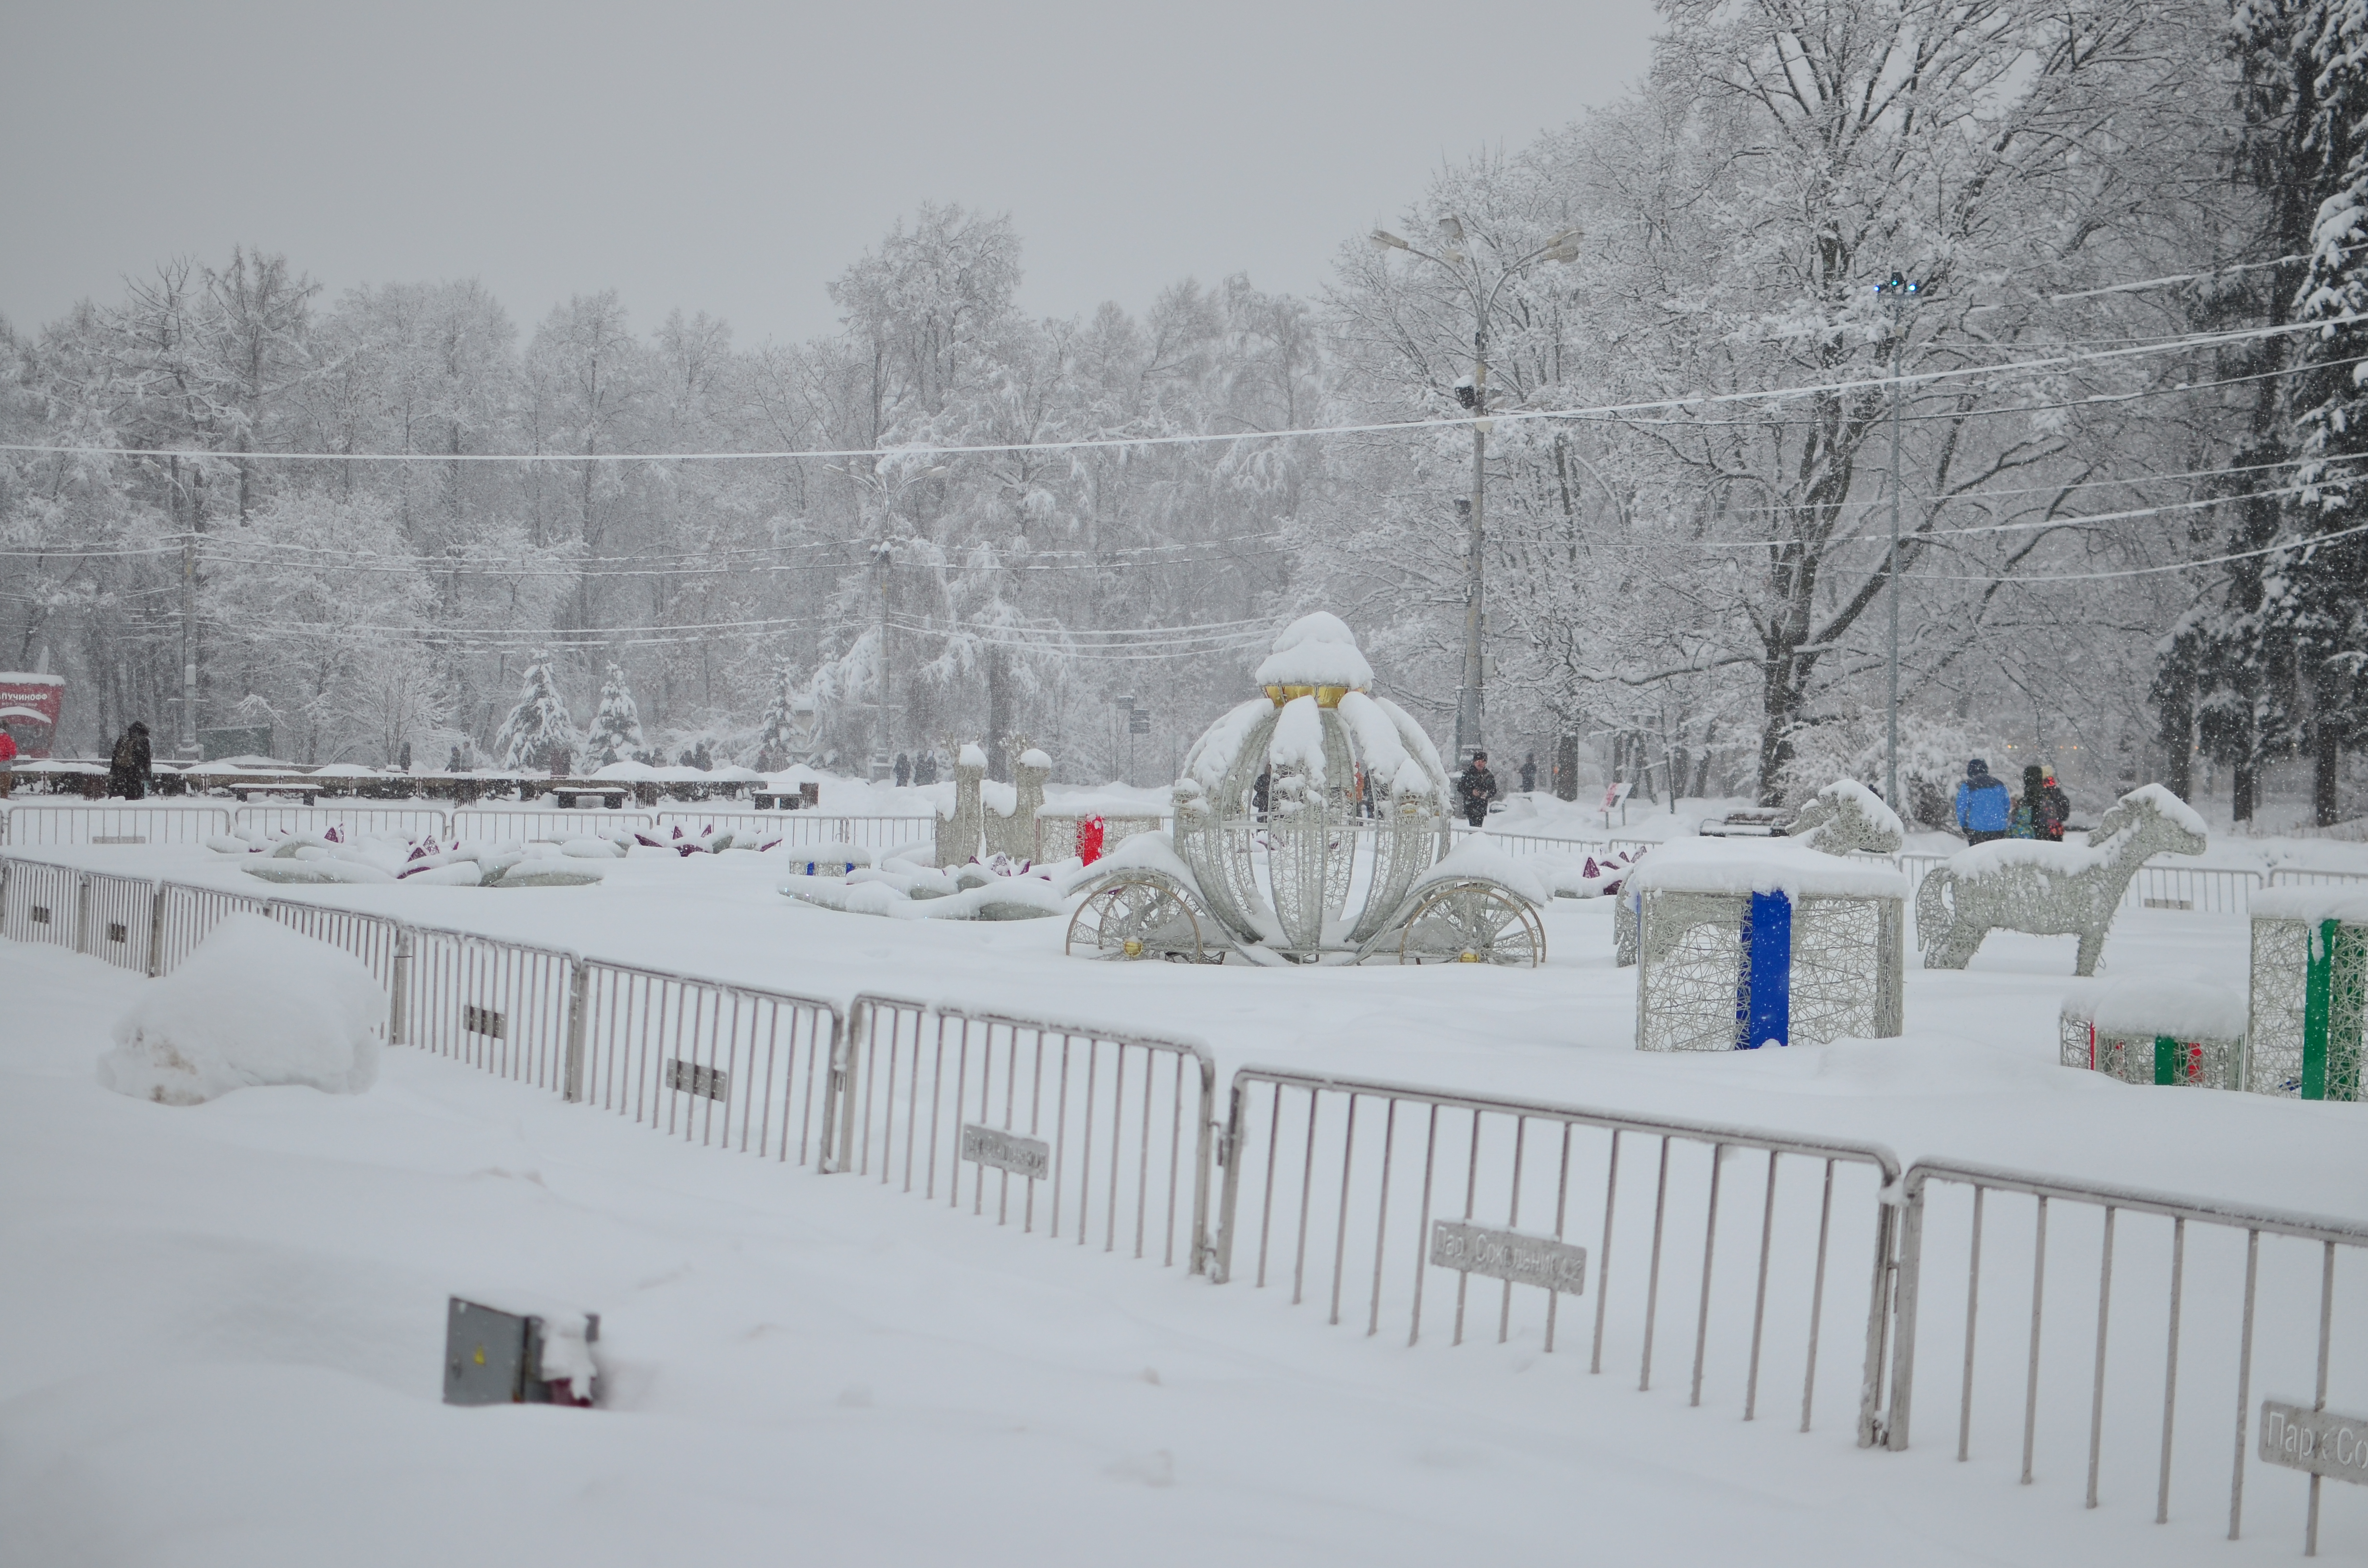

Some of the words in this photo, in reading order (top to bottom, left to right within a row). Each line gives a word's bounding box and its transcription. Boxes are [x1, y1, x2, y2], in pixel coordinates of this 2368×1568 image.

[0, 692, 48, 700] ПУЧИНОФФ
[1436, 1225, 1468, 1259] Пар
[2268, 1411, 2328, 1461] Парк
